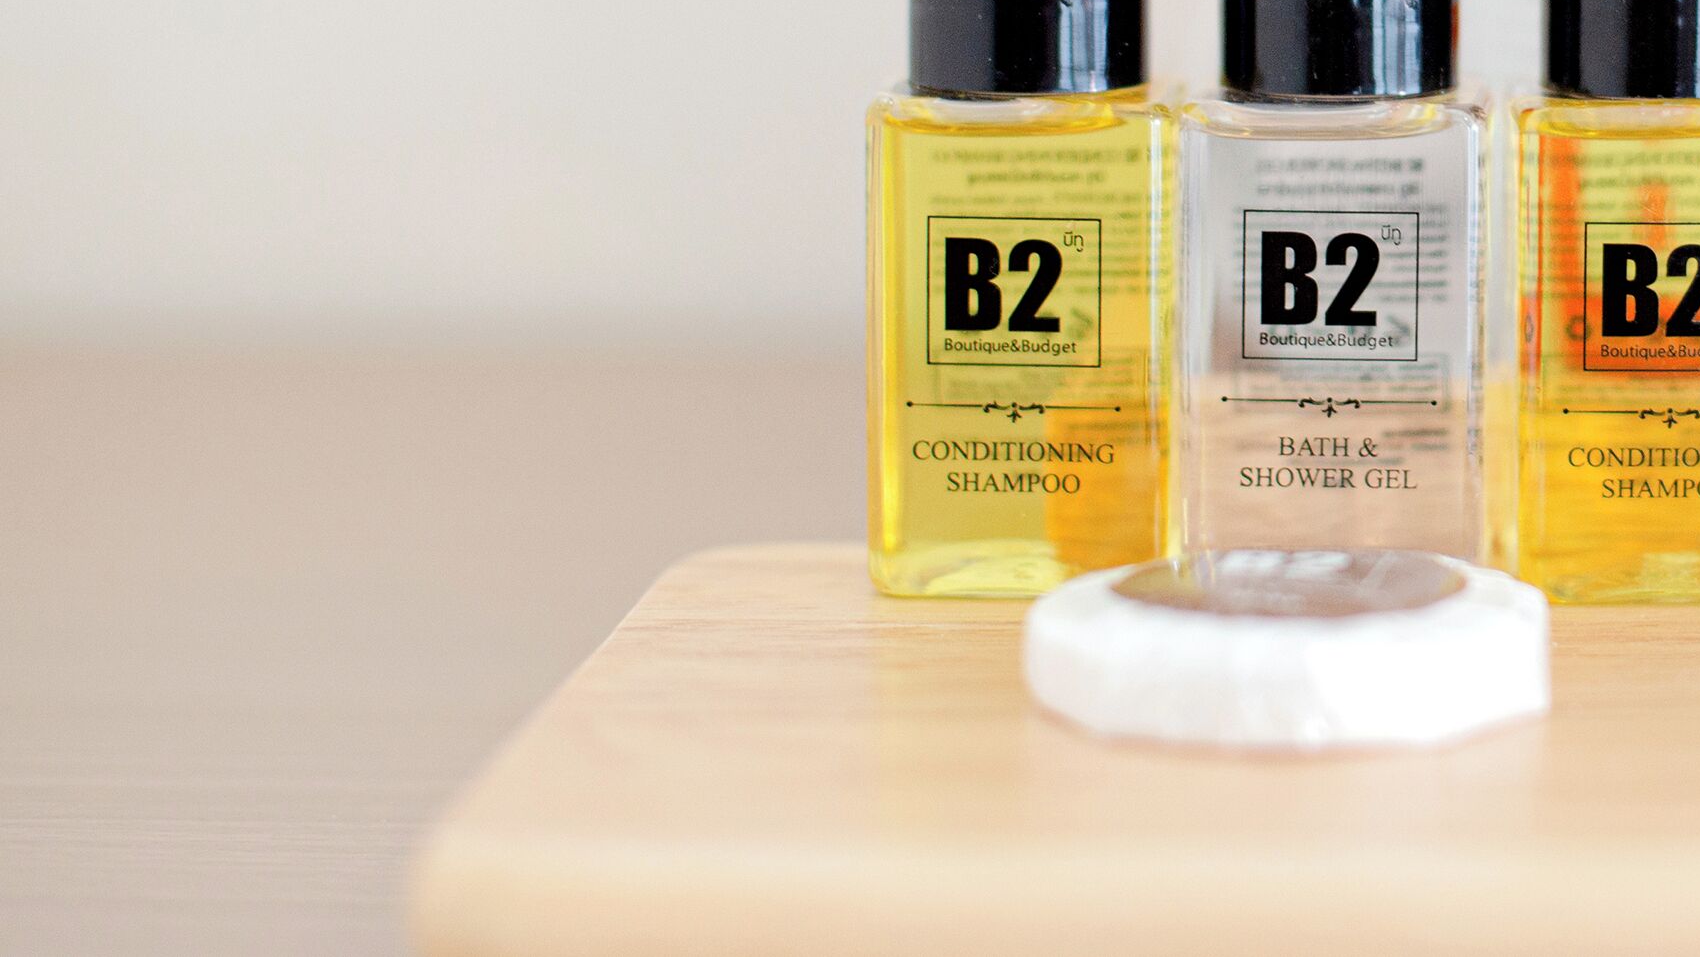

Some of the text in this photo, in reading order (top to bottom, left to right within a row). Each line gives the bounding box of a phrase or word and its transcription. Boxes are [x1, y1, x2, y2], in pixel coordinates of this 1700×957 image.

[944, 237, 1063, 333] B2
[1261, 231, 1380, 327] B2
[944, 338, 1077, 356] Boutique&Budget
[1259, 331, 1394, 350] Boutique&Budget
[912, 440, 1115, 464] CONDITIONING
[1279, 436, 1350, 458] BATH
[1358, 437, 1379, 458] &
[947, 472, 1081, 494] SHAMPOO
[1239, 467, 1418, 490] SHOWER GEL
